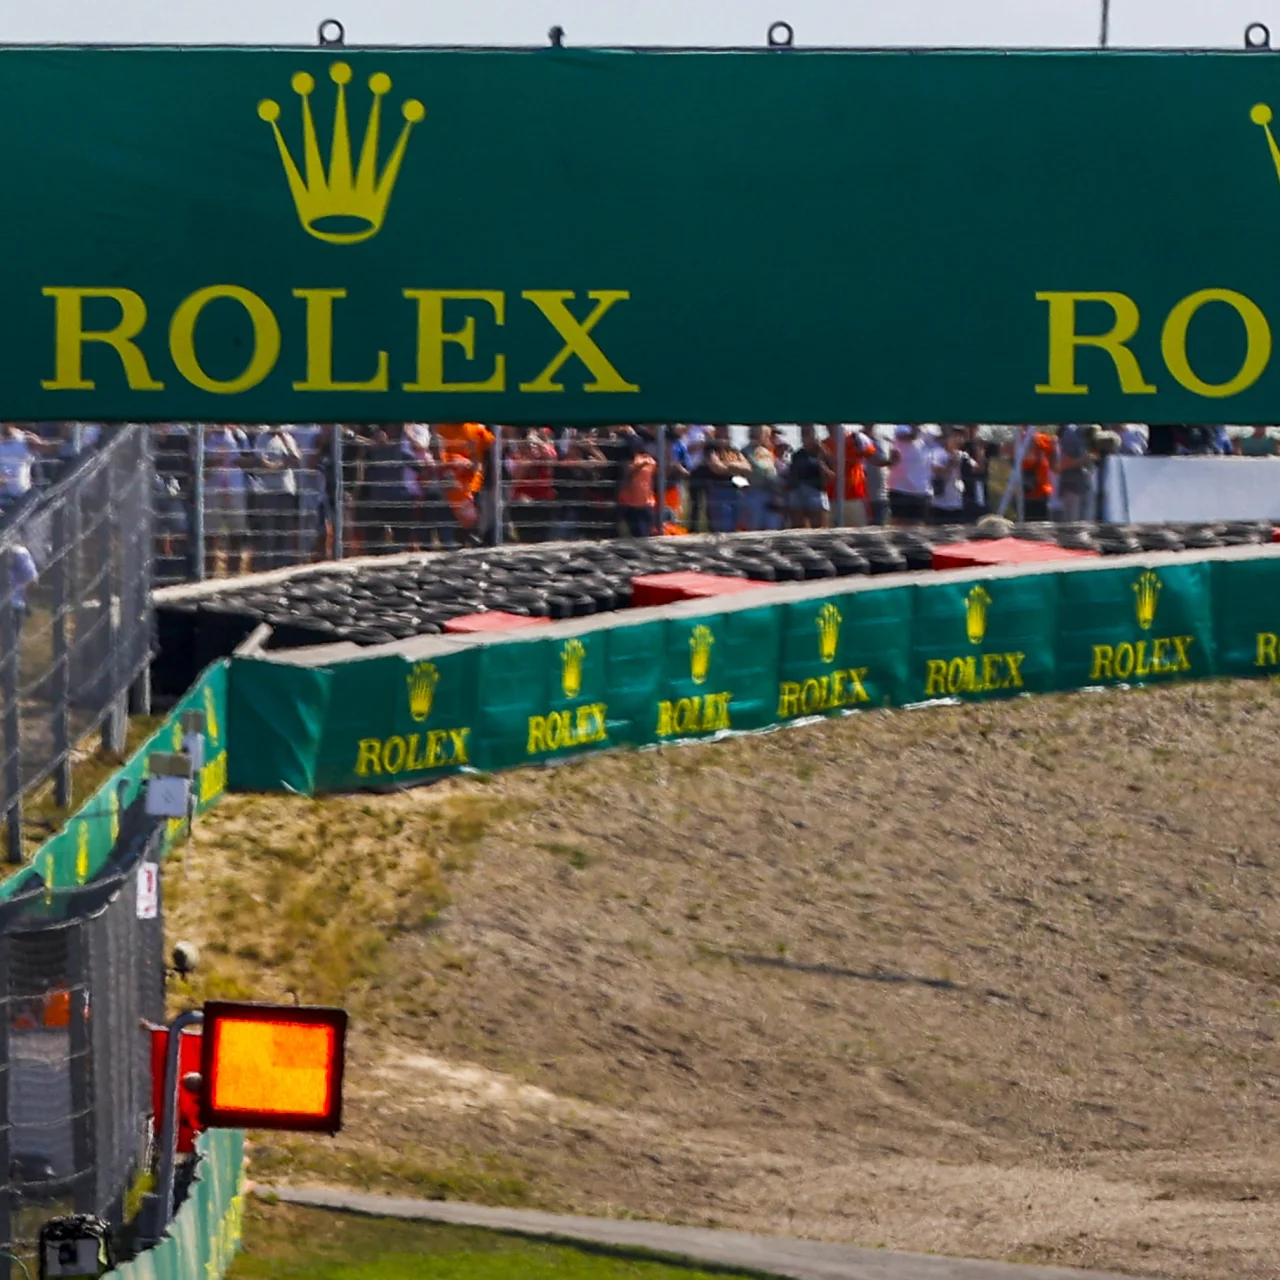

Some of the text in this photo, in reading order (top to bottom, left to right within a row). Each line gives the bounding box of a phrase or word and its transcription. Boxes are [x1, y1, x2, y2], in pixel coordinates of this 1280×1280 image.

[41, 284, 640, 394] ROLEX
[925, 651, 1025, 696] ROLEX
[1090, 635, 1194, 680] ROLEX
[657, 691, 732, 737] ROLEX
[777, 667, 869, 719] ROLEX
[355, 727, 470, 777] ROLEX
[526, 703, 608, 755] ROLEX
